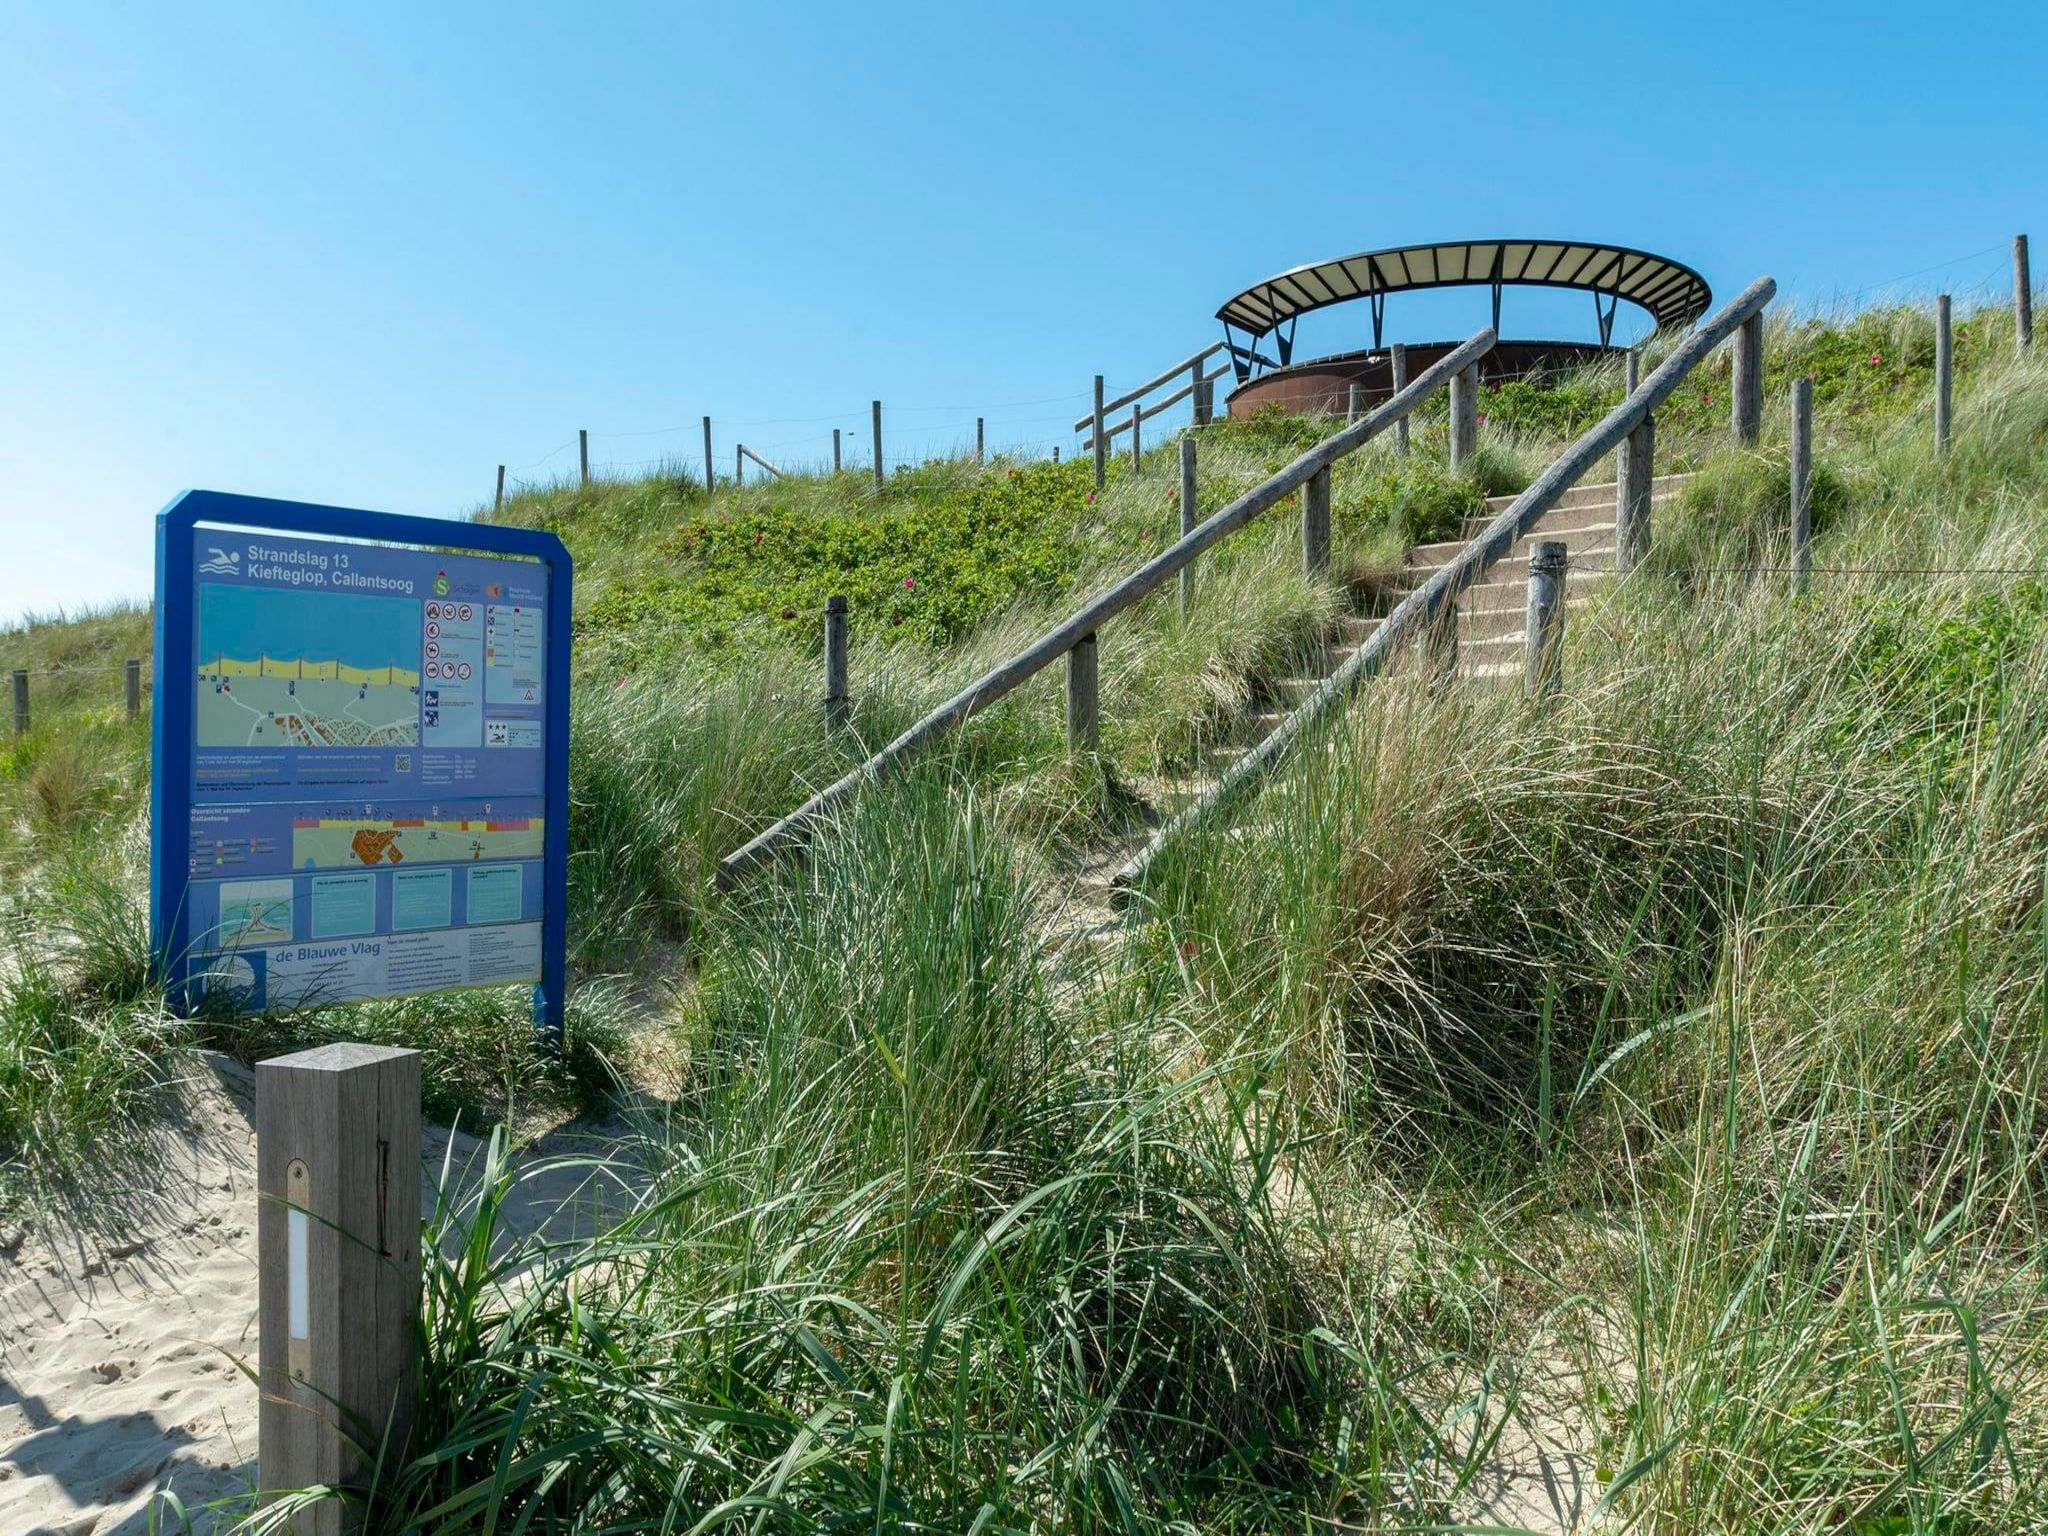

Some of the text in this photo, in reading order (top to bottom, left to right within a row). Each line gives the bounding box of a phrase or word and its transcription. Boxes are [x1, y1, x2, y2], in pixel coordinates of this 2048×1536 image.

[247, 545, 349, 569] Strandslag 13
[247, 563, 414, 594] Kiefteglop, Callantsoog
[190, 815, 229, 823] Callantsoog
[275, 942, 381, 963] de Blauwe Vlag
